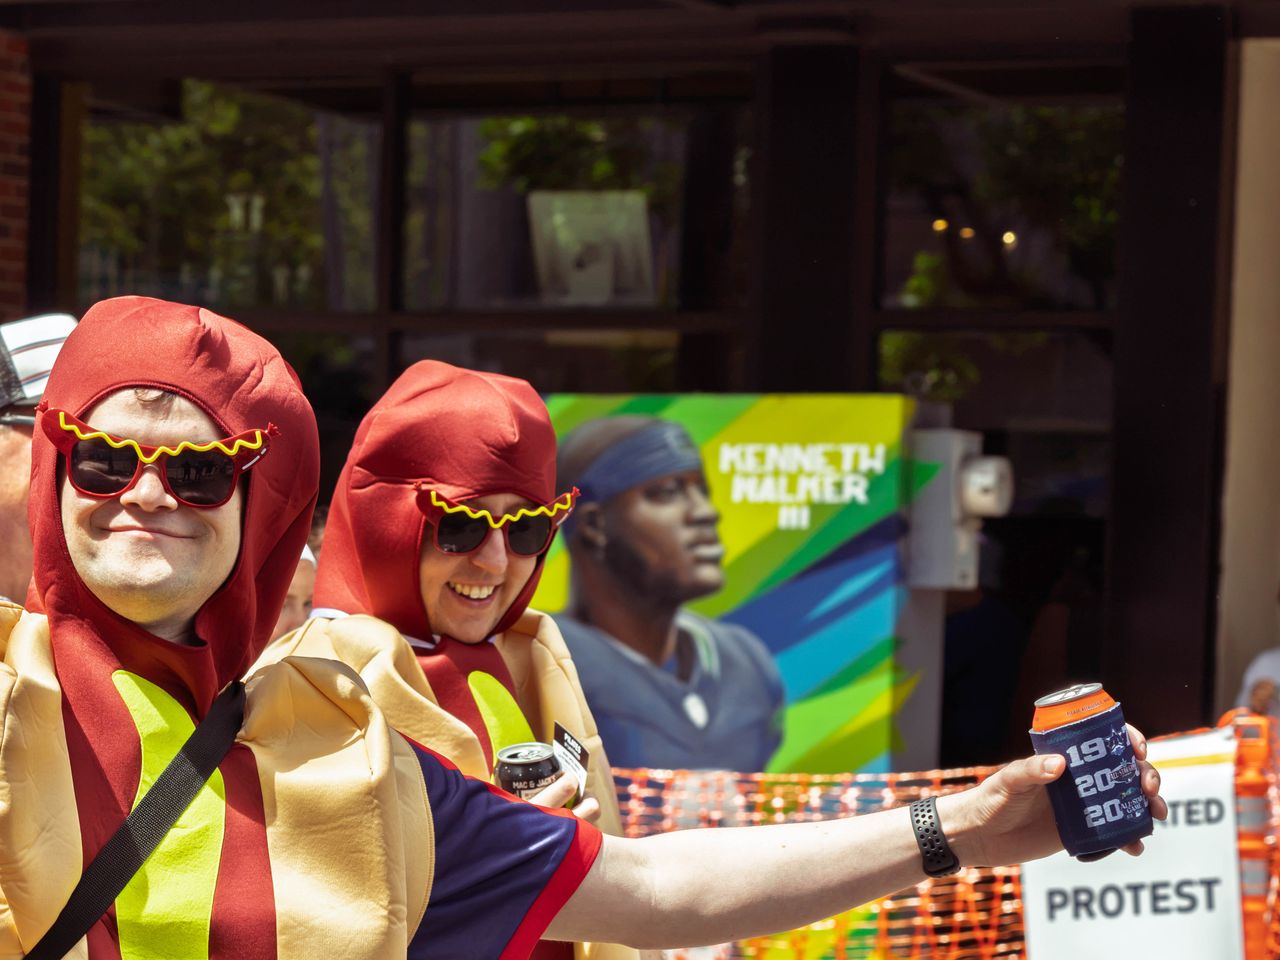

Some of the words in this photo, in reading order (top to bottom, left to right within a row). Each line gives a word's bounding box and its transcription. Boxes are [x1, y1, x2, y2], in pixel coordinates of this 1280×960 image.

[720, 443, 886, 475] KENNETH
[731, 473, 869, 504] WALKER
[778, 505, 811, 530] III
[512, 781, 528, 789] MAC
[1045, 877, 1222, 922] PROTEST
